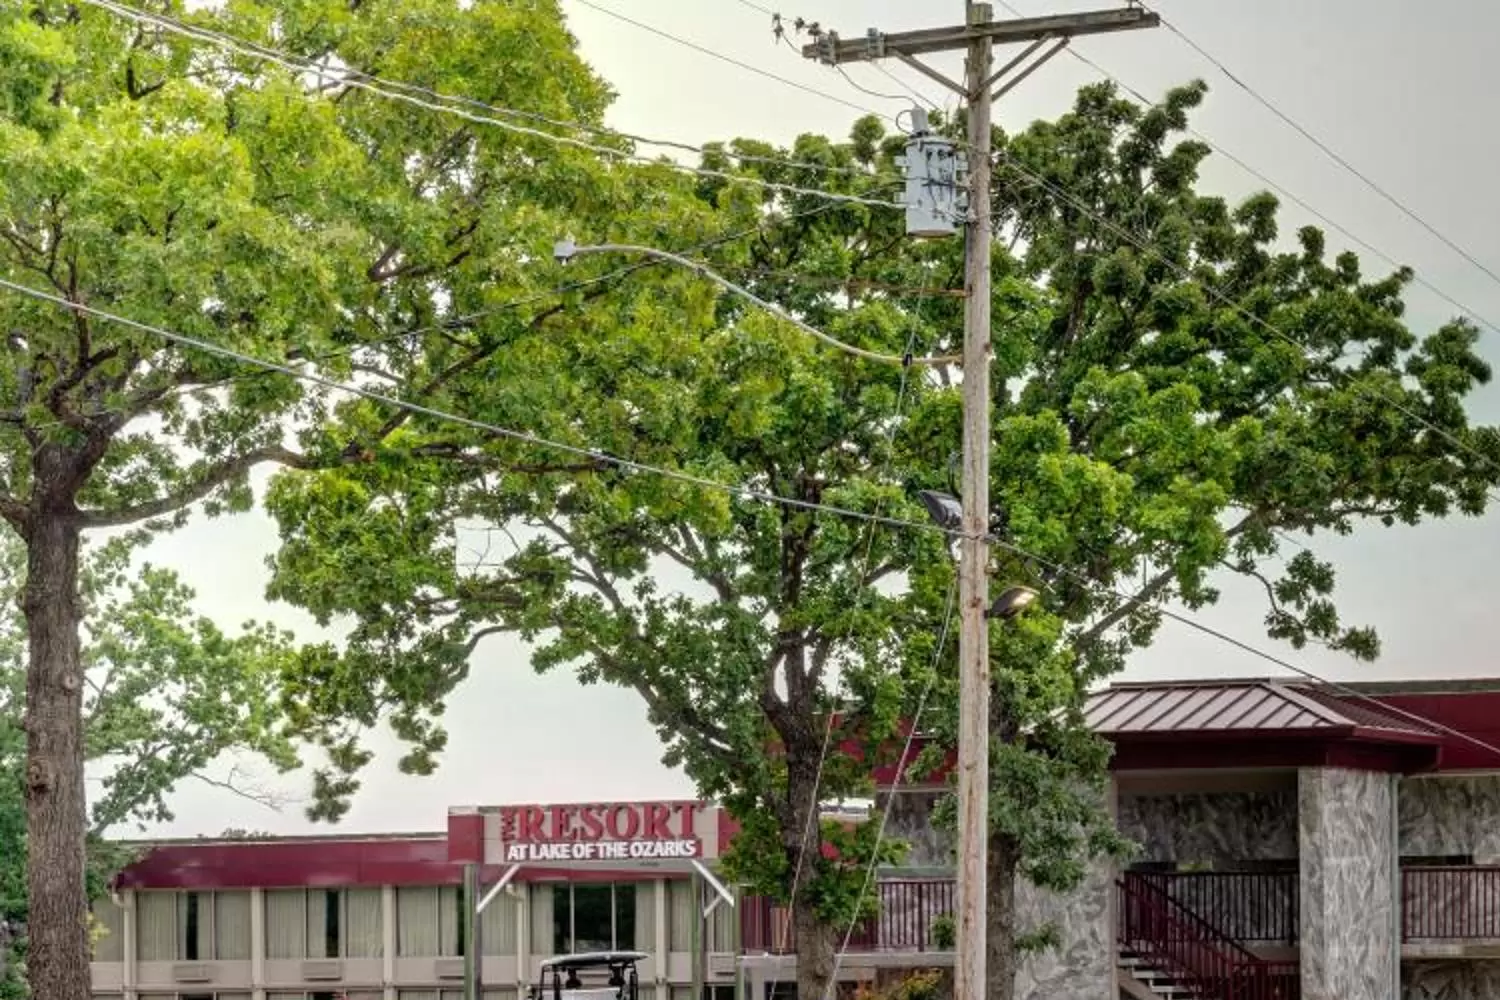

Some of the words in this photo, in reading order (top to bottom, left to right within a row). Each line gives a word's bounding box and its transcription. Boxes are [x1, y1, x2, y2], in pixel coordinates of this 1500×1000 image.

[514, 800, 706, 842] RESORT
[508, 844, 529, 860] AT
[530, 843, 570, 859] LAKE
[572, 843, 595, 858] OF
[595, 842, 628, 858] THE
[629, 840, 696, 857] OZARKS
